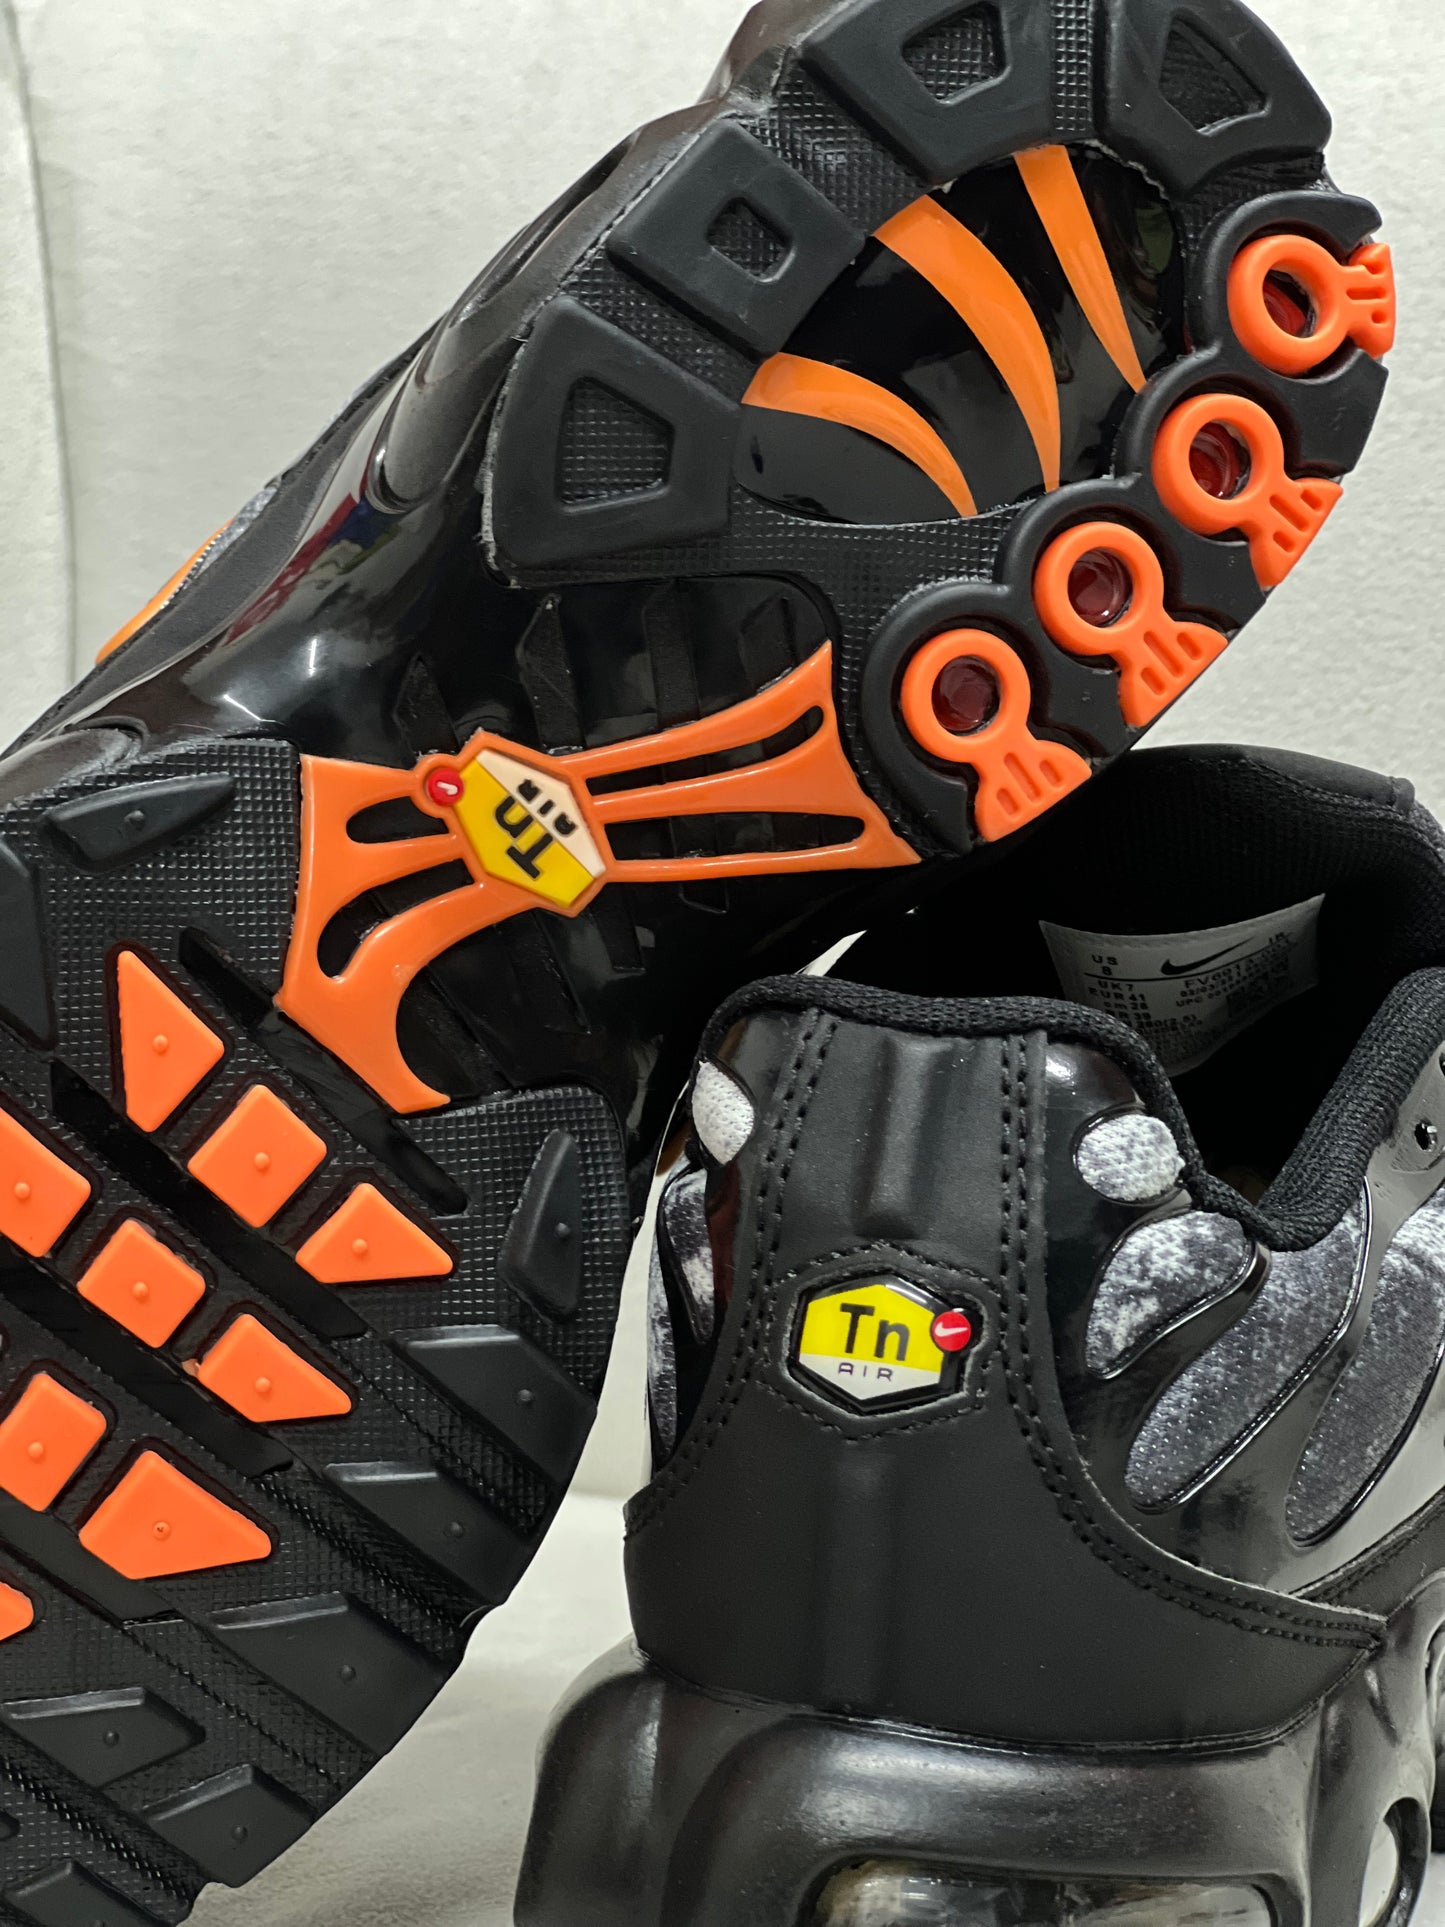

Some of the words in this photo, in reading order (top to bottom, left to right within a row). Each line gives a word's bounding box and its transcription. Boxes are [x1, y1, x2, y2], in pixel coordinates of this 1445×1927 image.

[1091, 953, 1119, 966] US
[1097, 979, 1123, 991] UK
[1125, 983, 1134, 992] 7
[1087, 986, 1126, 1001] EUR
[1128, 992, 1147, 1002] 41
[839, 1302, 910, 1362] Tn
[838, 1361, 894, 1382] AIR
